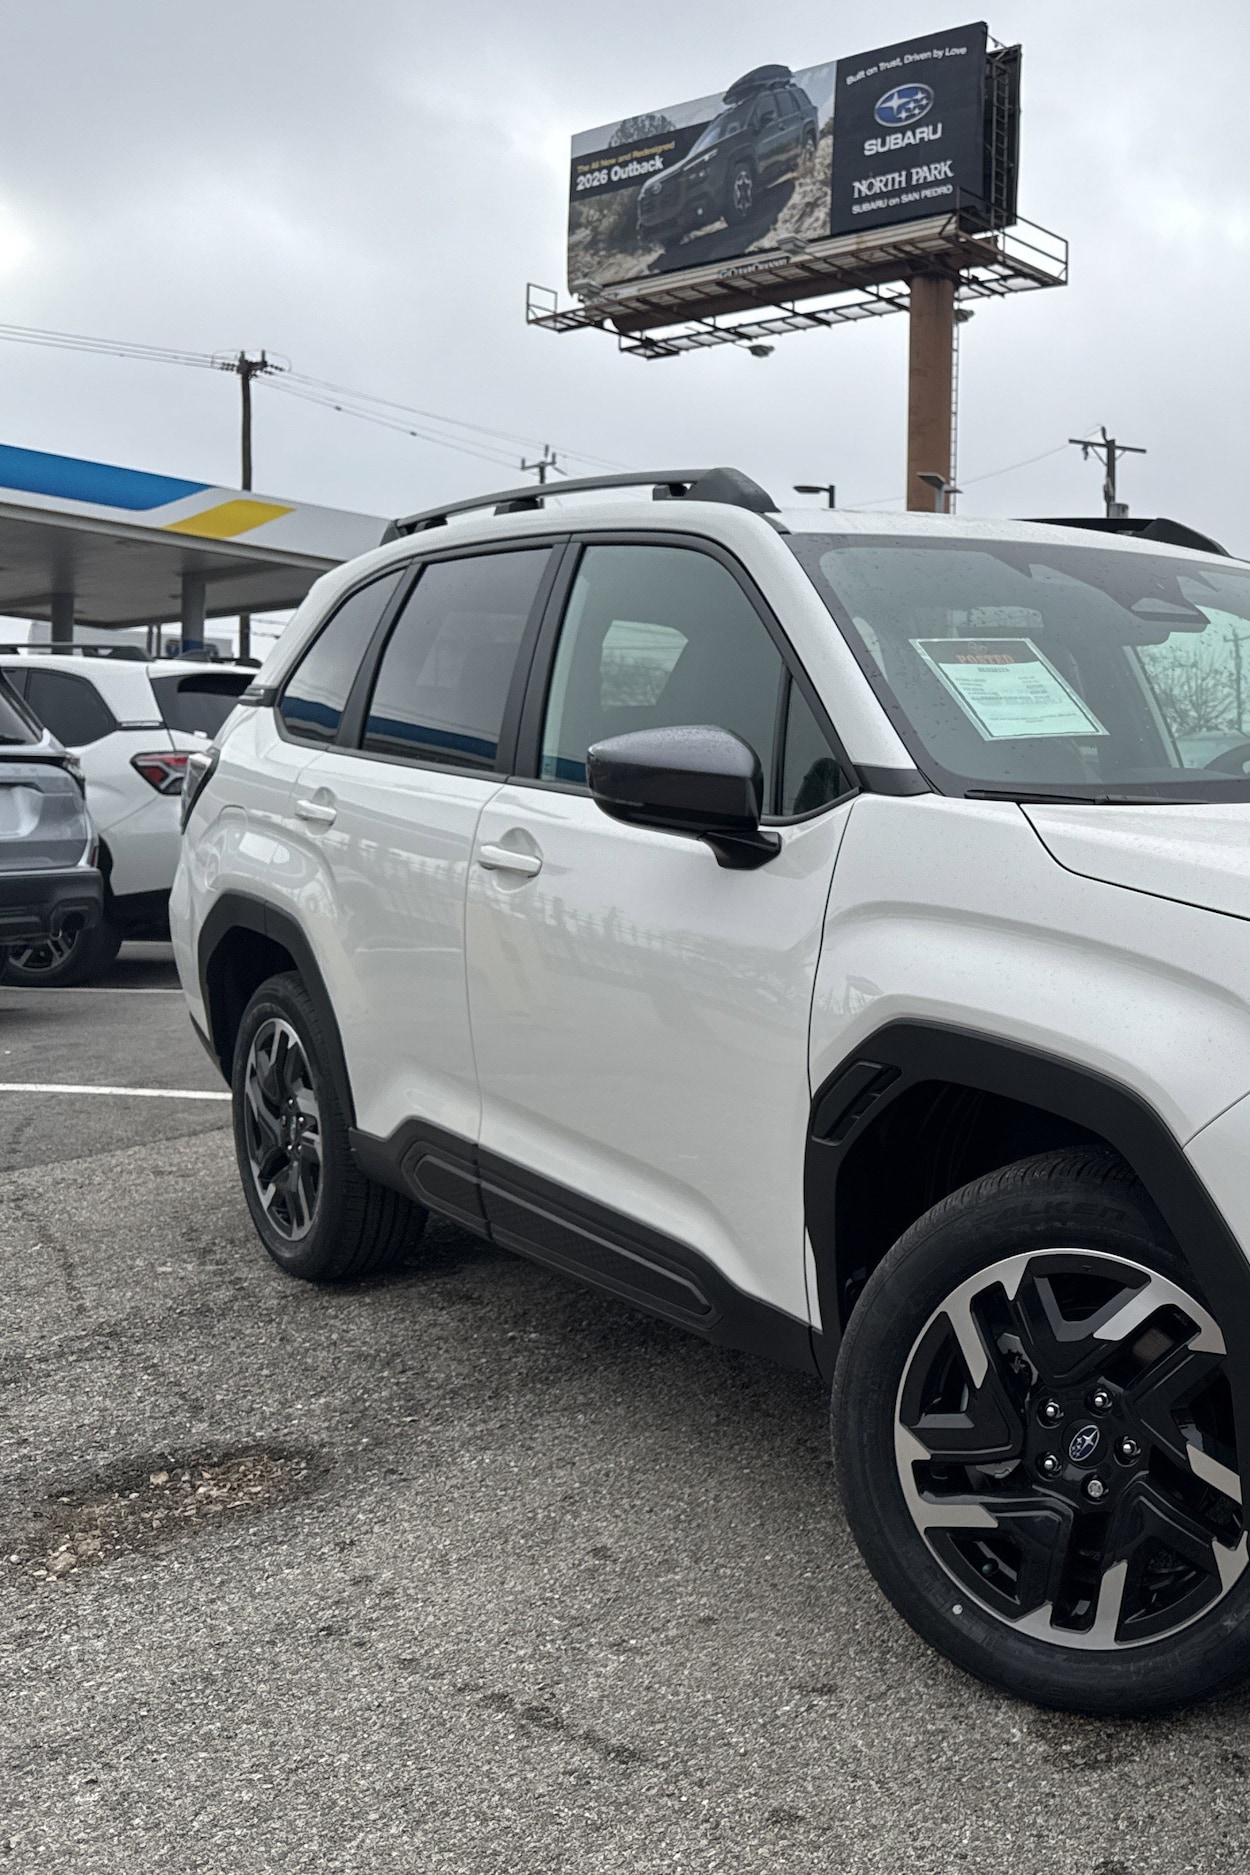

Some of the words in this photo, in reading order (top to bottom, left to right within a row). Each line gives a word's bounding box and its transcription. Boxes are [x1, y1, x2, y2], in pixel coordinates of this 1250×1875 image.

[846, 70, 866, 85] Built
[866, 66, 878, 76] on
[904, 51, 931, 64] Driven
[933, 49, 944, 59] by
[945, 47, 967, 57] Love
[863, 122, 942, 156] SUBARU
[576, 169, 608, 191] 2026
[610, 155, 664, 181] Outback
[617, 153, 632, 163] and
[852, 170, 907, 198] NORTH
[910, 159, 954, 185] PARK
[851, 198, 888, 214] SUBARU
[888, 197, 900, 206] on
[901, 191, 920, 204] SAN
[921, 184, 953, 199] PEDRO
